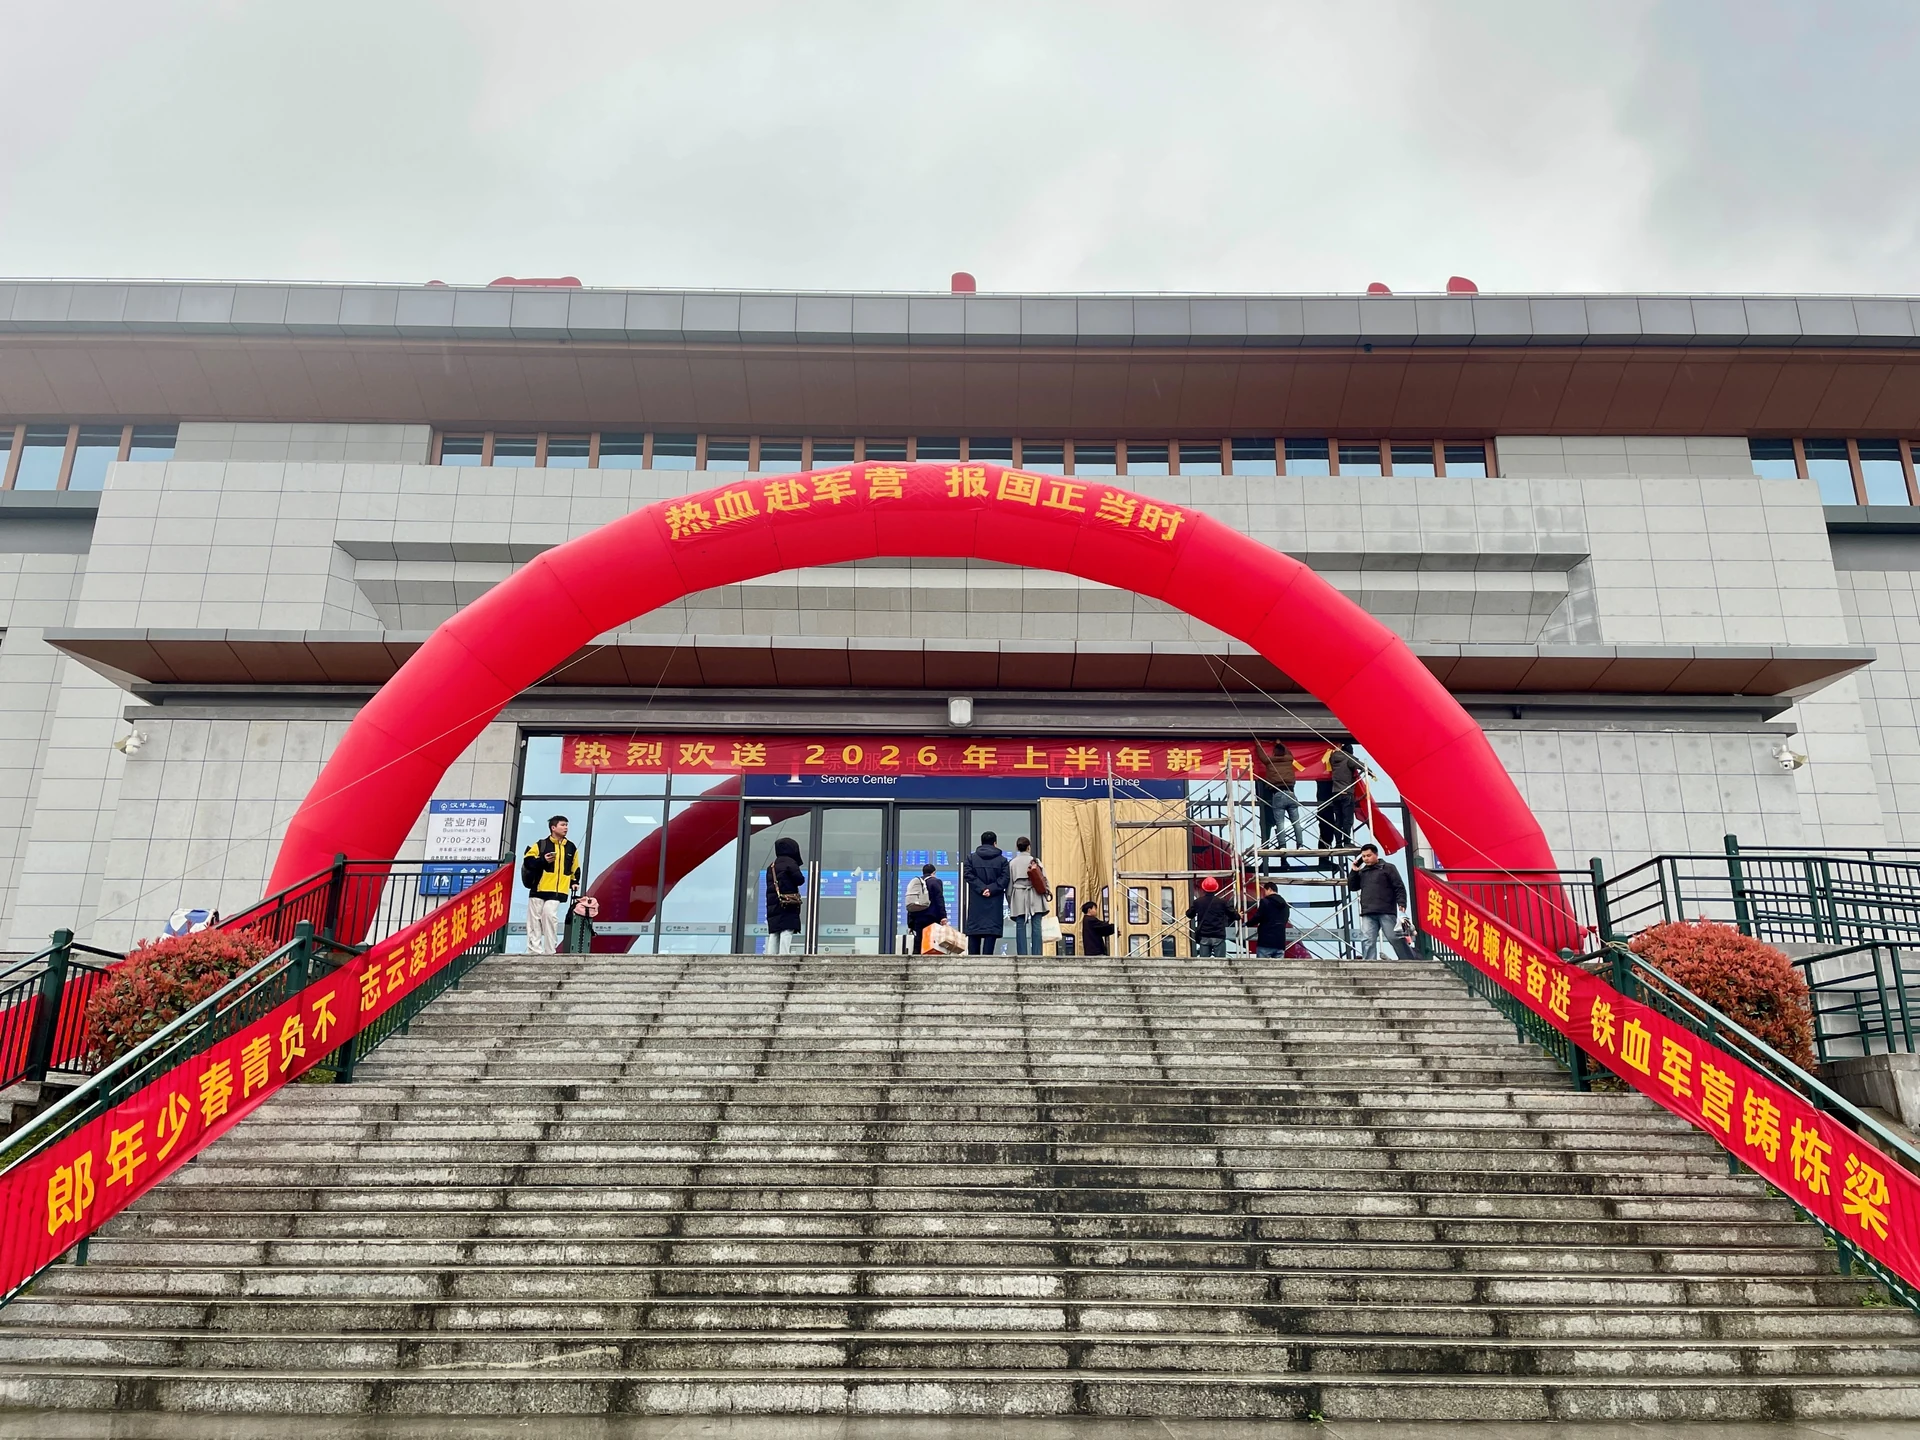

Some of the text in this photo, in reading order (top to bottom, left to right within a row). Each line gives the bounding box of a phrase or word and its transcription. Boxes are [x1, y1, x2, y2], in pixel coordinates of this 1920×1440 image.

[664, 467, 1186, 542] 热血赴军营 报国正当时
[574, 741, 767, 767] 热烈欢送
[820, 774, 898, 785] Service Center
[444, 817, 488, 827] 营业时间
[436, 836, 491, 844] 07:00-22:30
[1425, 886, 1892, 1242] 策马扬鞭催奋进 铁血军营铸栋梁
